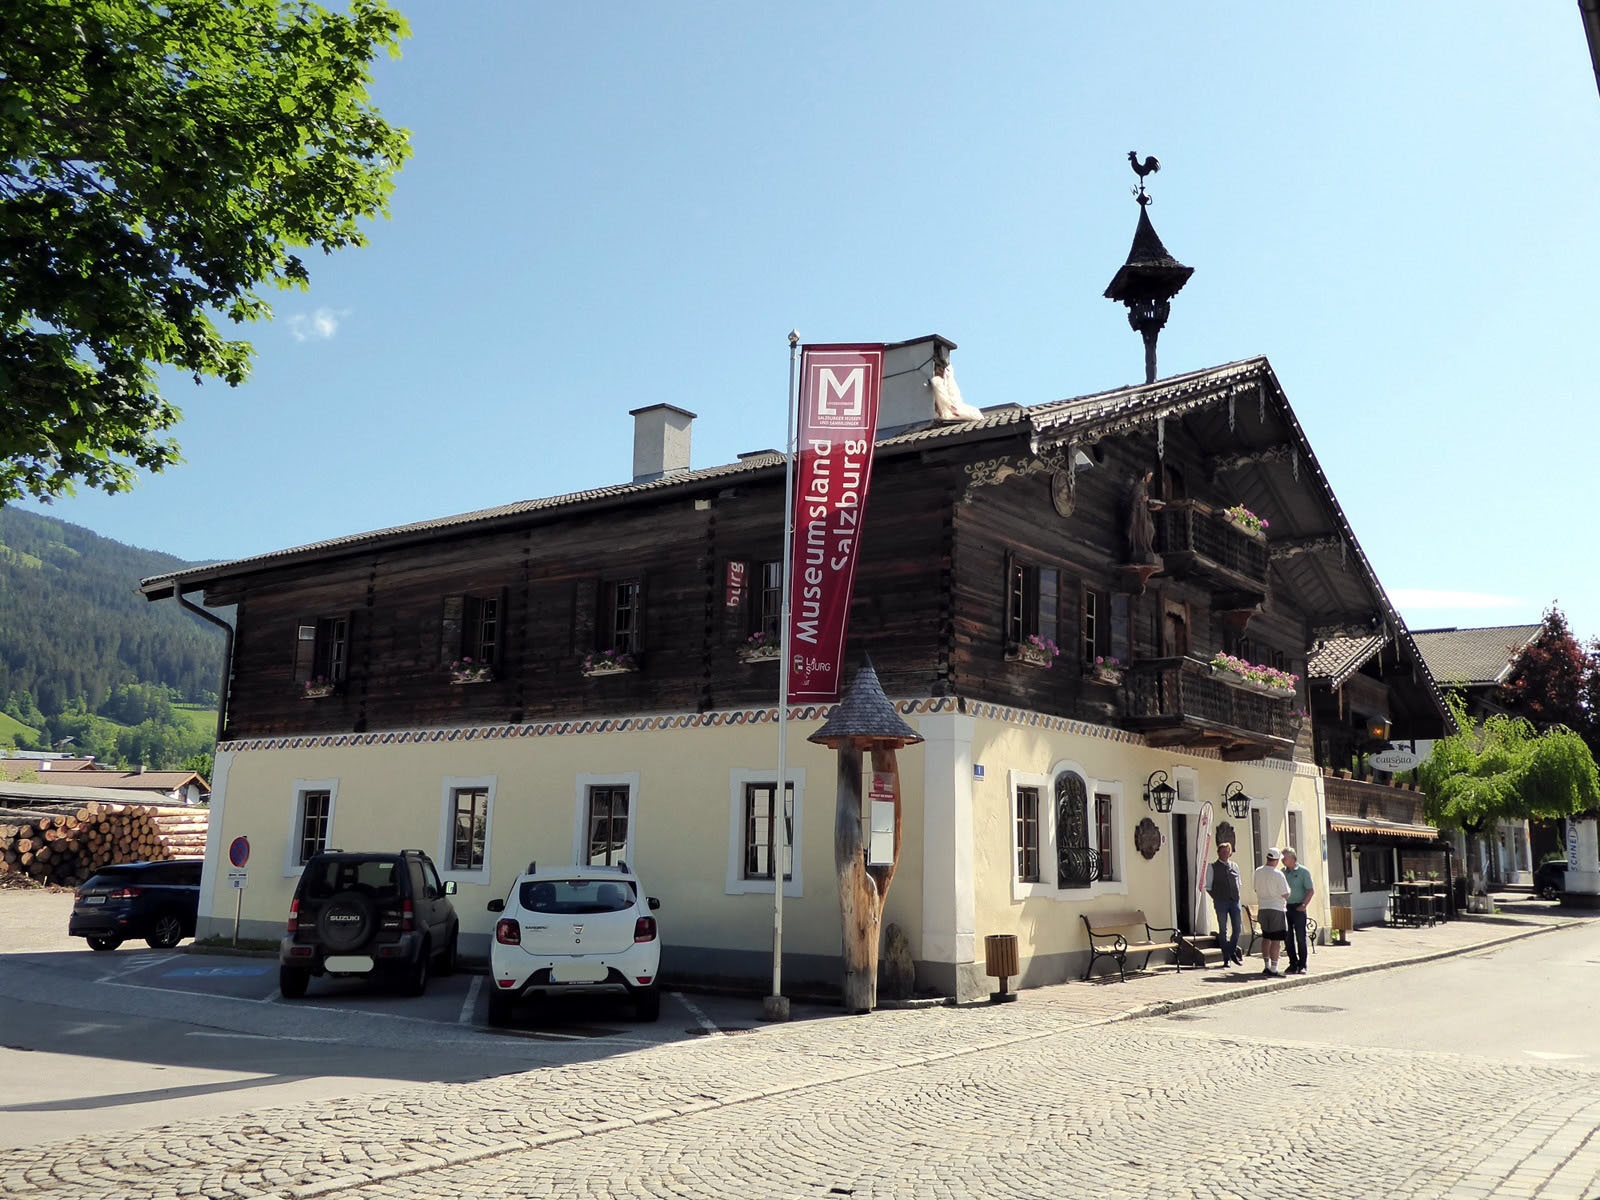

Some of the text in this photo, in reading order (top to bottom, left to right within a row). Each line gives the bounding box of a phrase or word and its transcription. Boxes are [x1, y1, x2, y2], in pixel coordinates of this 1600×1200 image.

[796, 439, 832, 644] Museumsland
[831, 440, 867, 571] Salzburg
[1568, 820, 1578, 871] SCHNEIDE
